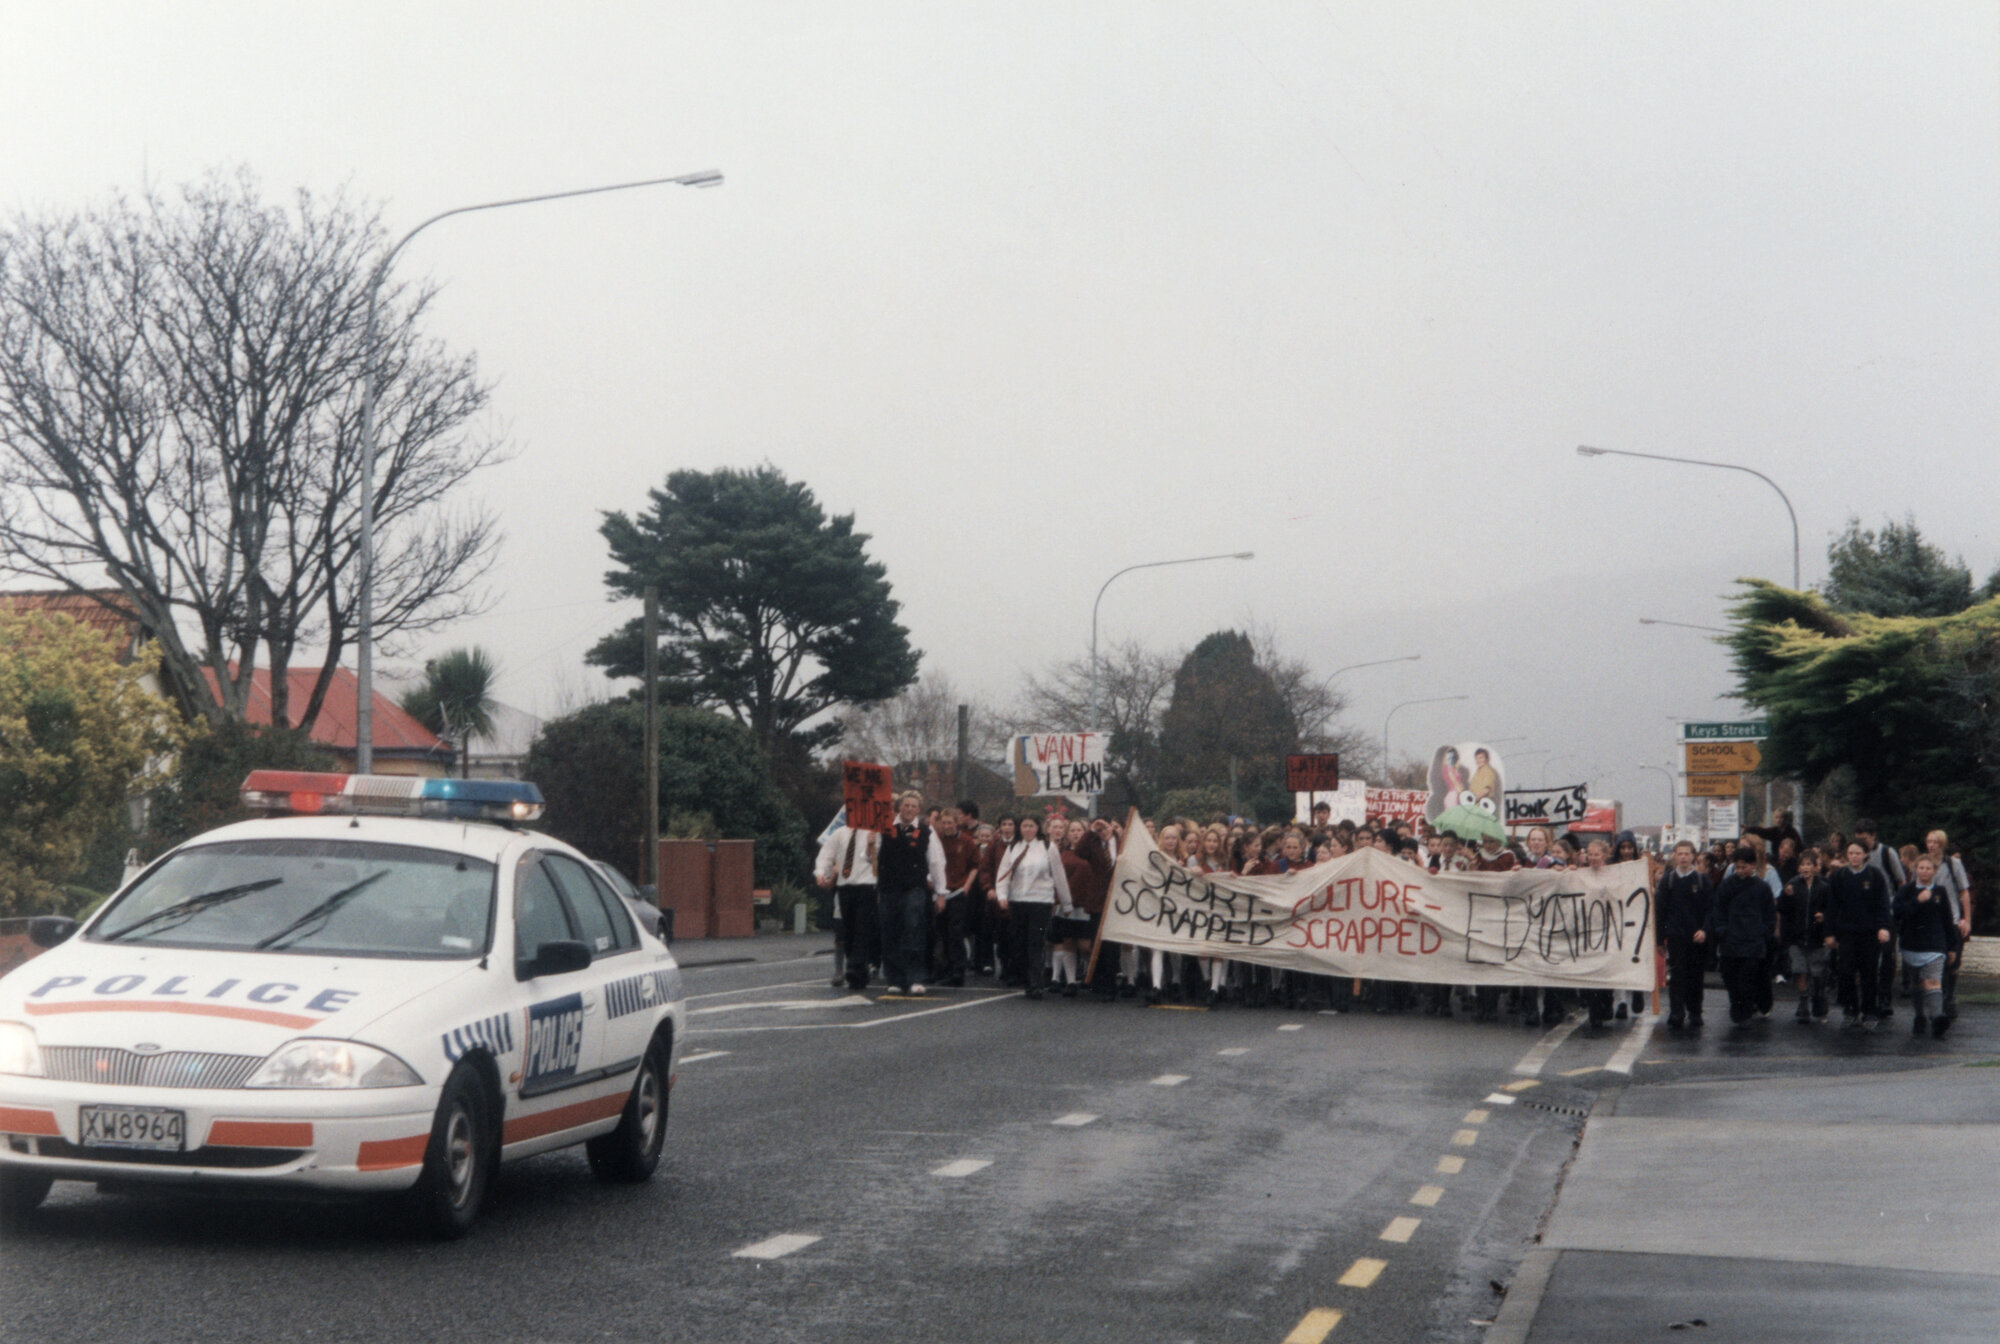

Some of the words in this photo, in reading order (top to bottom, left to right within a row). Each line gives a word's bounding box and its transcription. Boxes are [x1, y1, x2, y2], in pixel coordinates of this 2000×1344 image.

[1690, 725, 1718, 738] Keys
[1722, 724, 1756, 735] Street
[1034, 733, 1095, 764] WANT
[1692, 745, 1737, 755] SCHOOL
[1046, 761, 1102, 792] LEARN
[1391, 792, 1411, 800] THE
[1505, 798, 1549, 819] HONK
[1115, 879, 1274, 945] SCRAPPED
[1287, 917, 1442, 955] SCRAPPED
[29, 975, 361, 1013] POLICE
[526, 1010, 583, 1077] POLICE
[84, 1110, 182, 1142] XW8964
